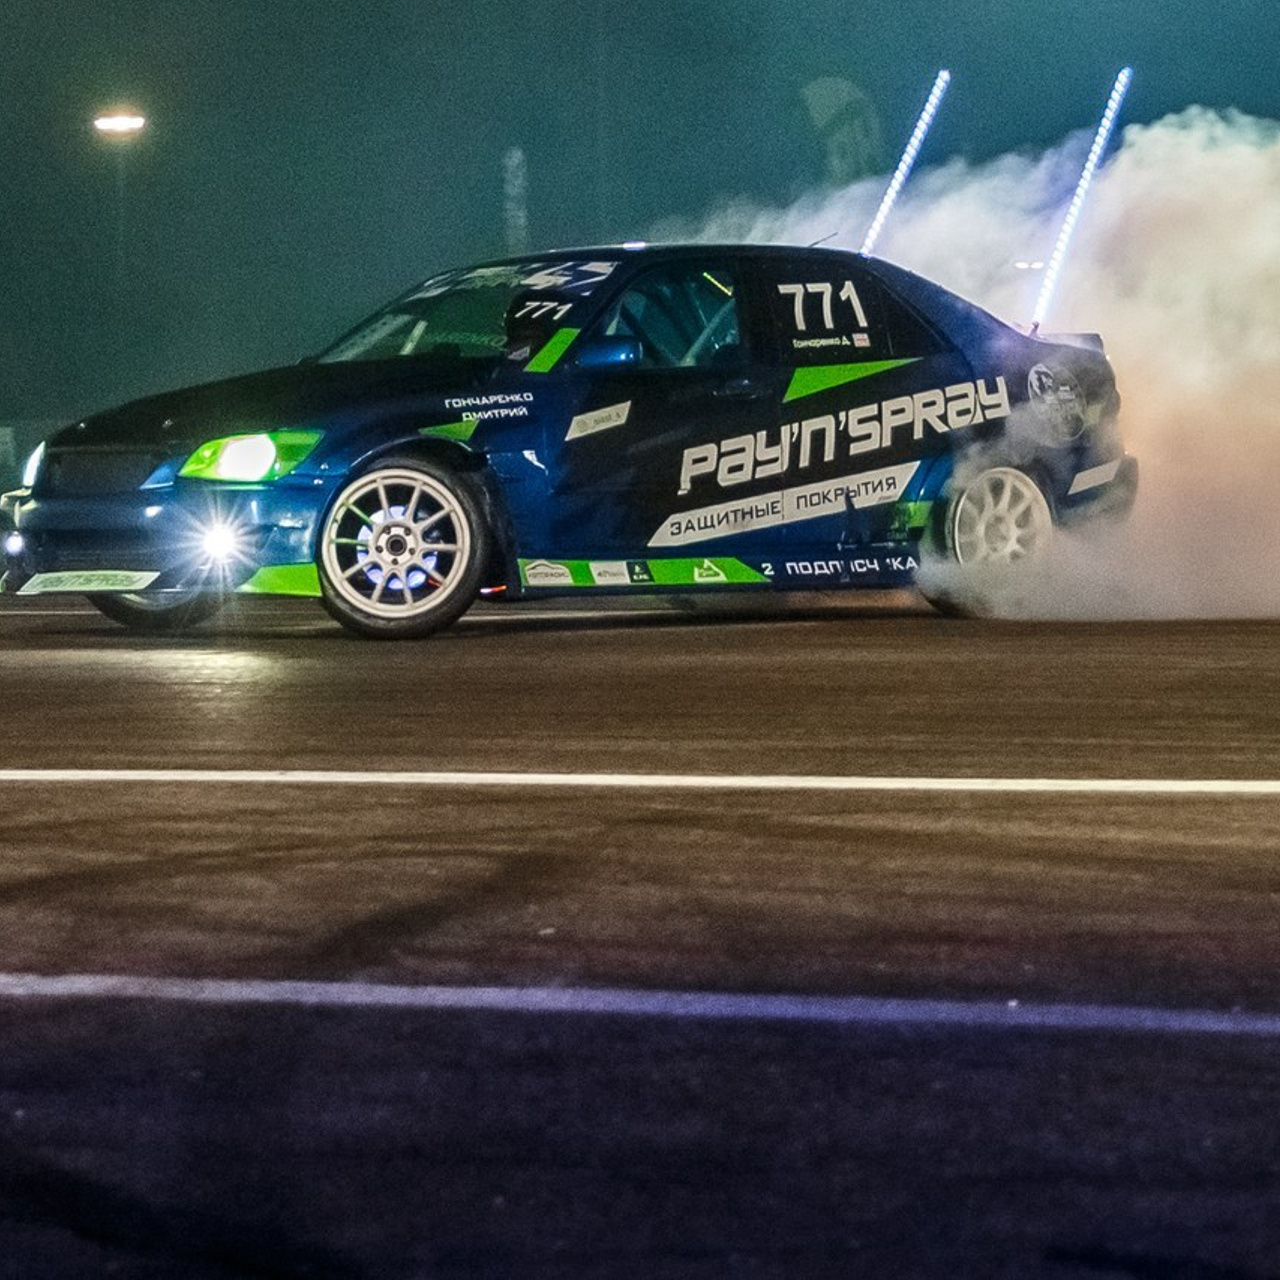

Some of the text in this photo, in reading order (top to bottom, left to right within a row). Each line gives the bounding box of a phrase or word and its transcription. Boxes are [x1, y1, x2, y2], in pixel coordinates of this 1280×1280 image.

[515, 301, 573, 320] 771
[777, 280, 868, 331] 771
[445, 392, 534, 409] ГОНЧАРЕНКО
[462, 405, 529, 422] ДМИТРИЙ
[670, 476, 897, 536] ЗАЩИТНЫЕ ПОКРЫТИЯ
